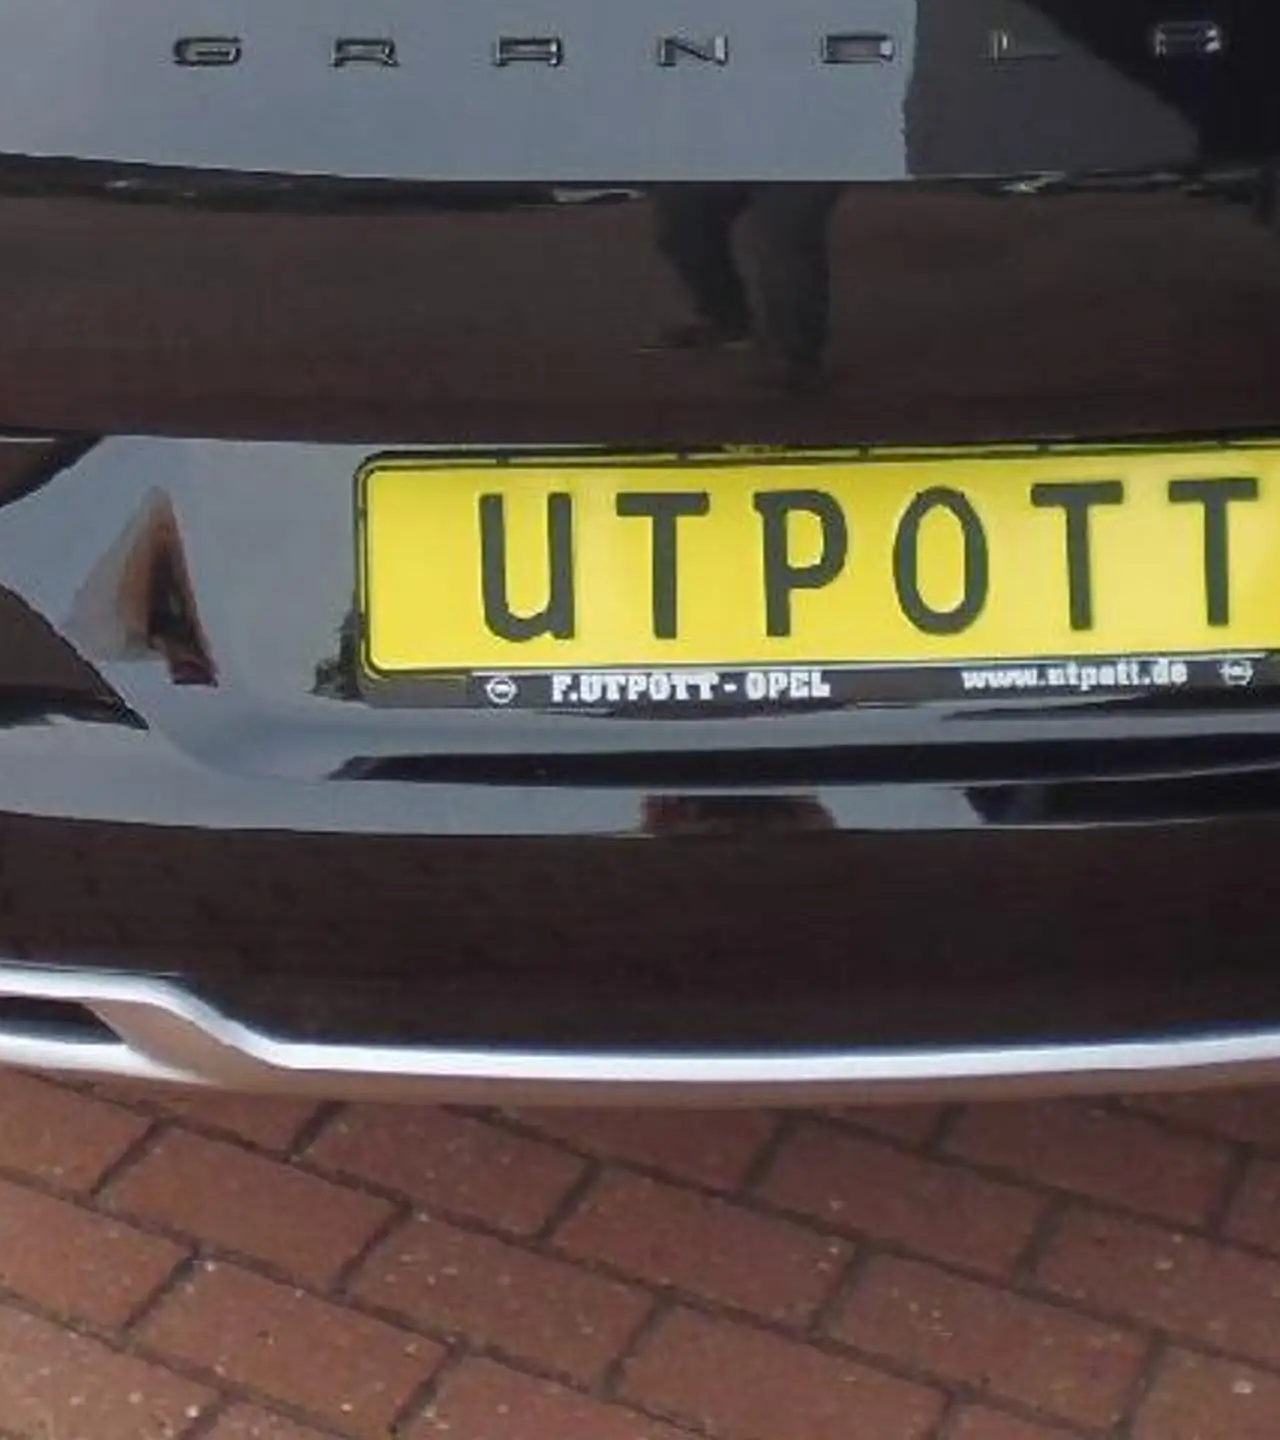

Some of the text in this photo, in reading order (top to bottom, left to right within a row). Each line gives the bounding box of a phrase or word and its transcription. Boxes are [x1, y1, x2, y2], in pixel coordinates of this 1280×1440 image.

[479, 476, 1260, 642] UTPOTT
[552, 671, 720, 702] F.UTPOTT
[744, 668, 831, 700] OPEL
